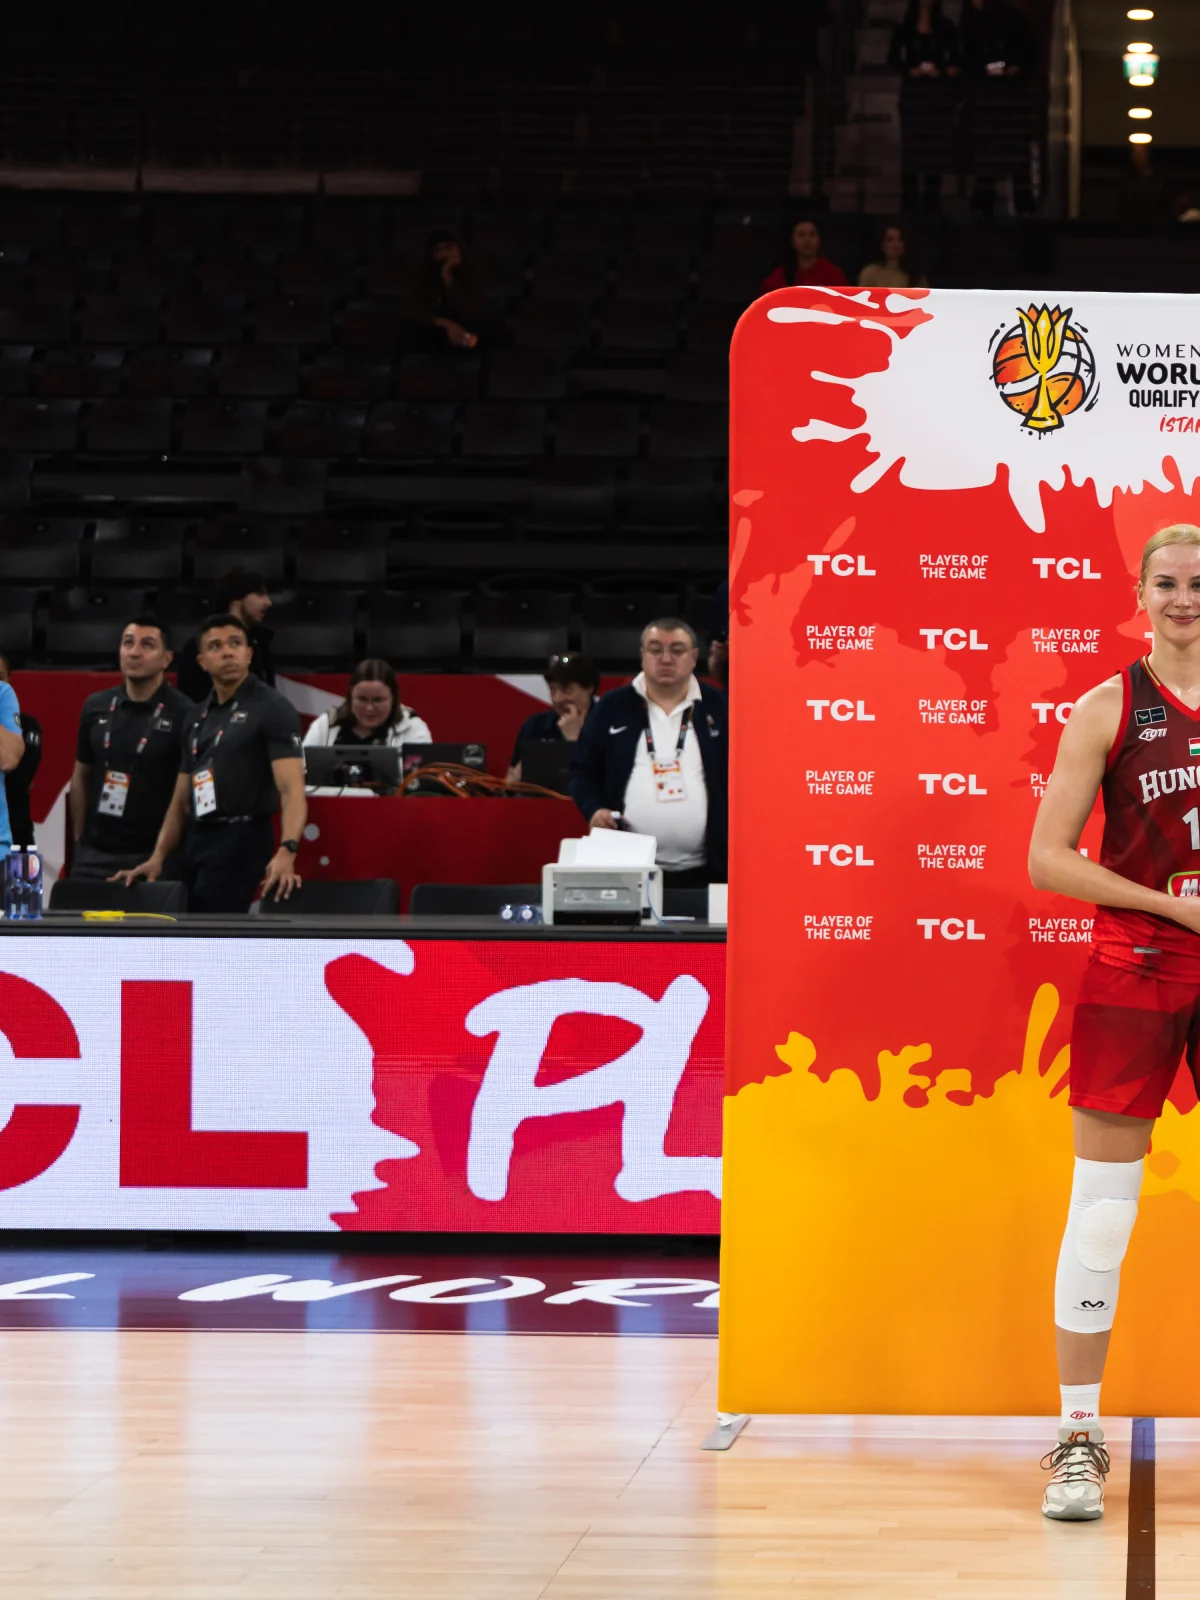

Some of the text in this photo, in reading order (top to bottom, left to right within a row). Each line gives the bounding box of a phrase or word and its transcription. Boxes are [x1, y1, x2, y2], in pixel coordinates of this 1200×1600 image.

[806, 553, 877, 577] TCL
[919, 554, 989, 567] PLAYER OF
[921, 567, 987, 579] THE GAME
[1032, 557, 1102, 580] TCL
[806, 625, 876, 637] PLAYER OF
[1031, 628, 1101, 641] PLAYER OF
[807, 638, 874, 651] THE GAME
[919, 627, 989, 651] TCL
[1033, 640, 1099, 654] THE GAME
[806, 698, 876, 722] TCL
[918, 699, 988, 711] PLAYER OF
[920, 711, 986, 725] THE GAME
[805, 770, 875, 783] PLAYER OF
[807, 783, 873, 795] THE GAME
[918, 772, 988, 796] TCL
[805, 843, 875, 867] TCL
[917, 844, 987, 857] PLAYER OF
[919, 857, 985, 869] THE GAME
[804, 915, 874, 927] PLAYER OF
[1029, 918, 1078, 930] PLAYER
[805, 927, 871, 940] THE GAME
[916, 917, 986, 941] TCL
[1030, 931, 1056, 943] THE
